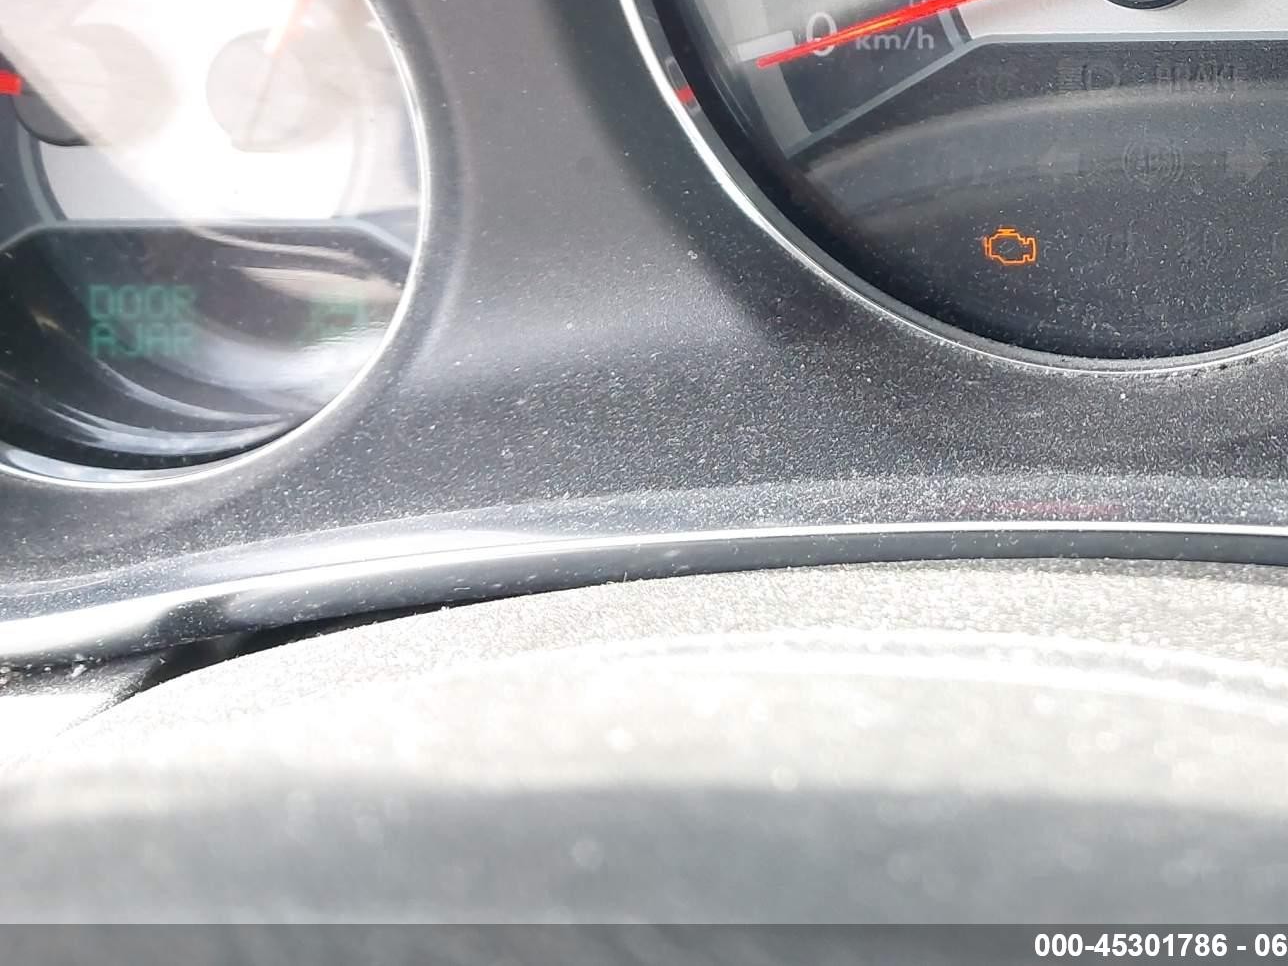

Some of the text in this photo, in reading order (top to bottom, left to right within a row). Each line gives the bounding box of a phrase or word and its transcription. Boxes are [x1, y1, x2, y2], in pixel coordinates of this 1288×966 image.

[806, 11, 838, 56] 0
[854, 26, 934, 51] km/h
[89, 286, 196, 320] DOOR
[90, 322, 195, 357] AJAR
